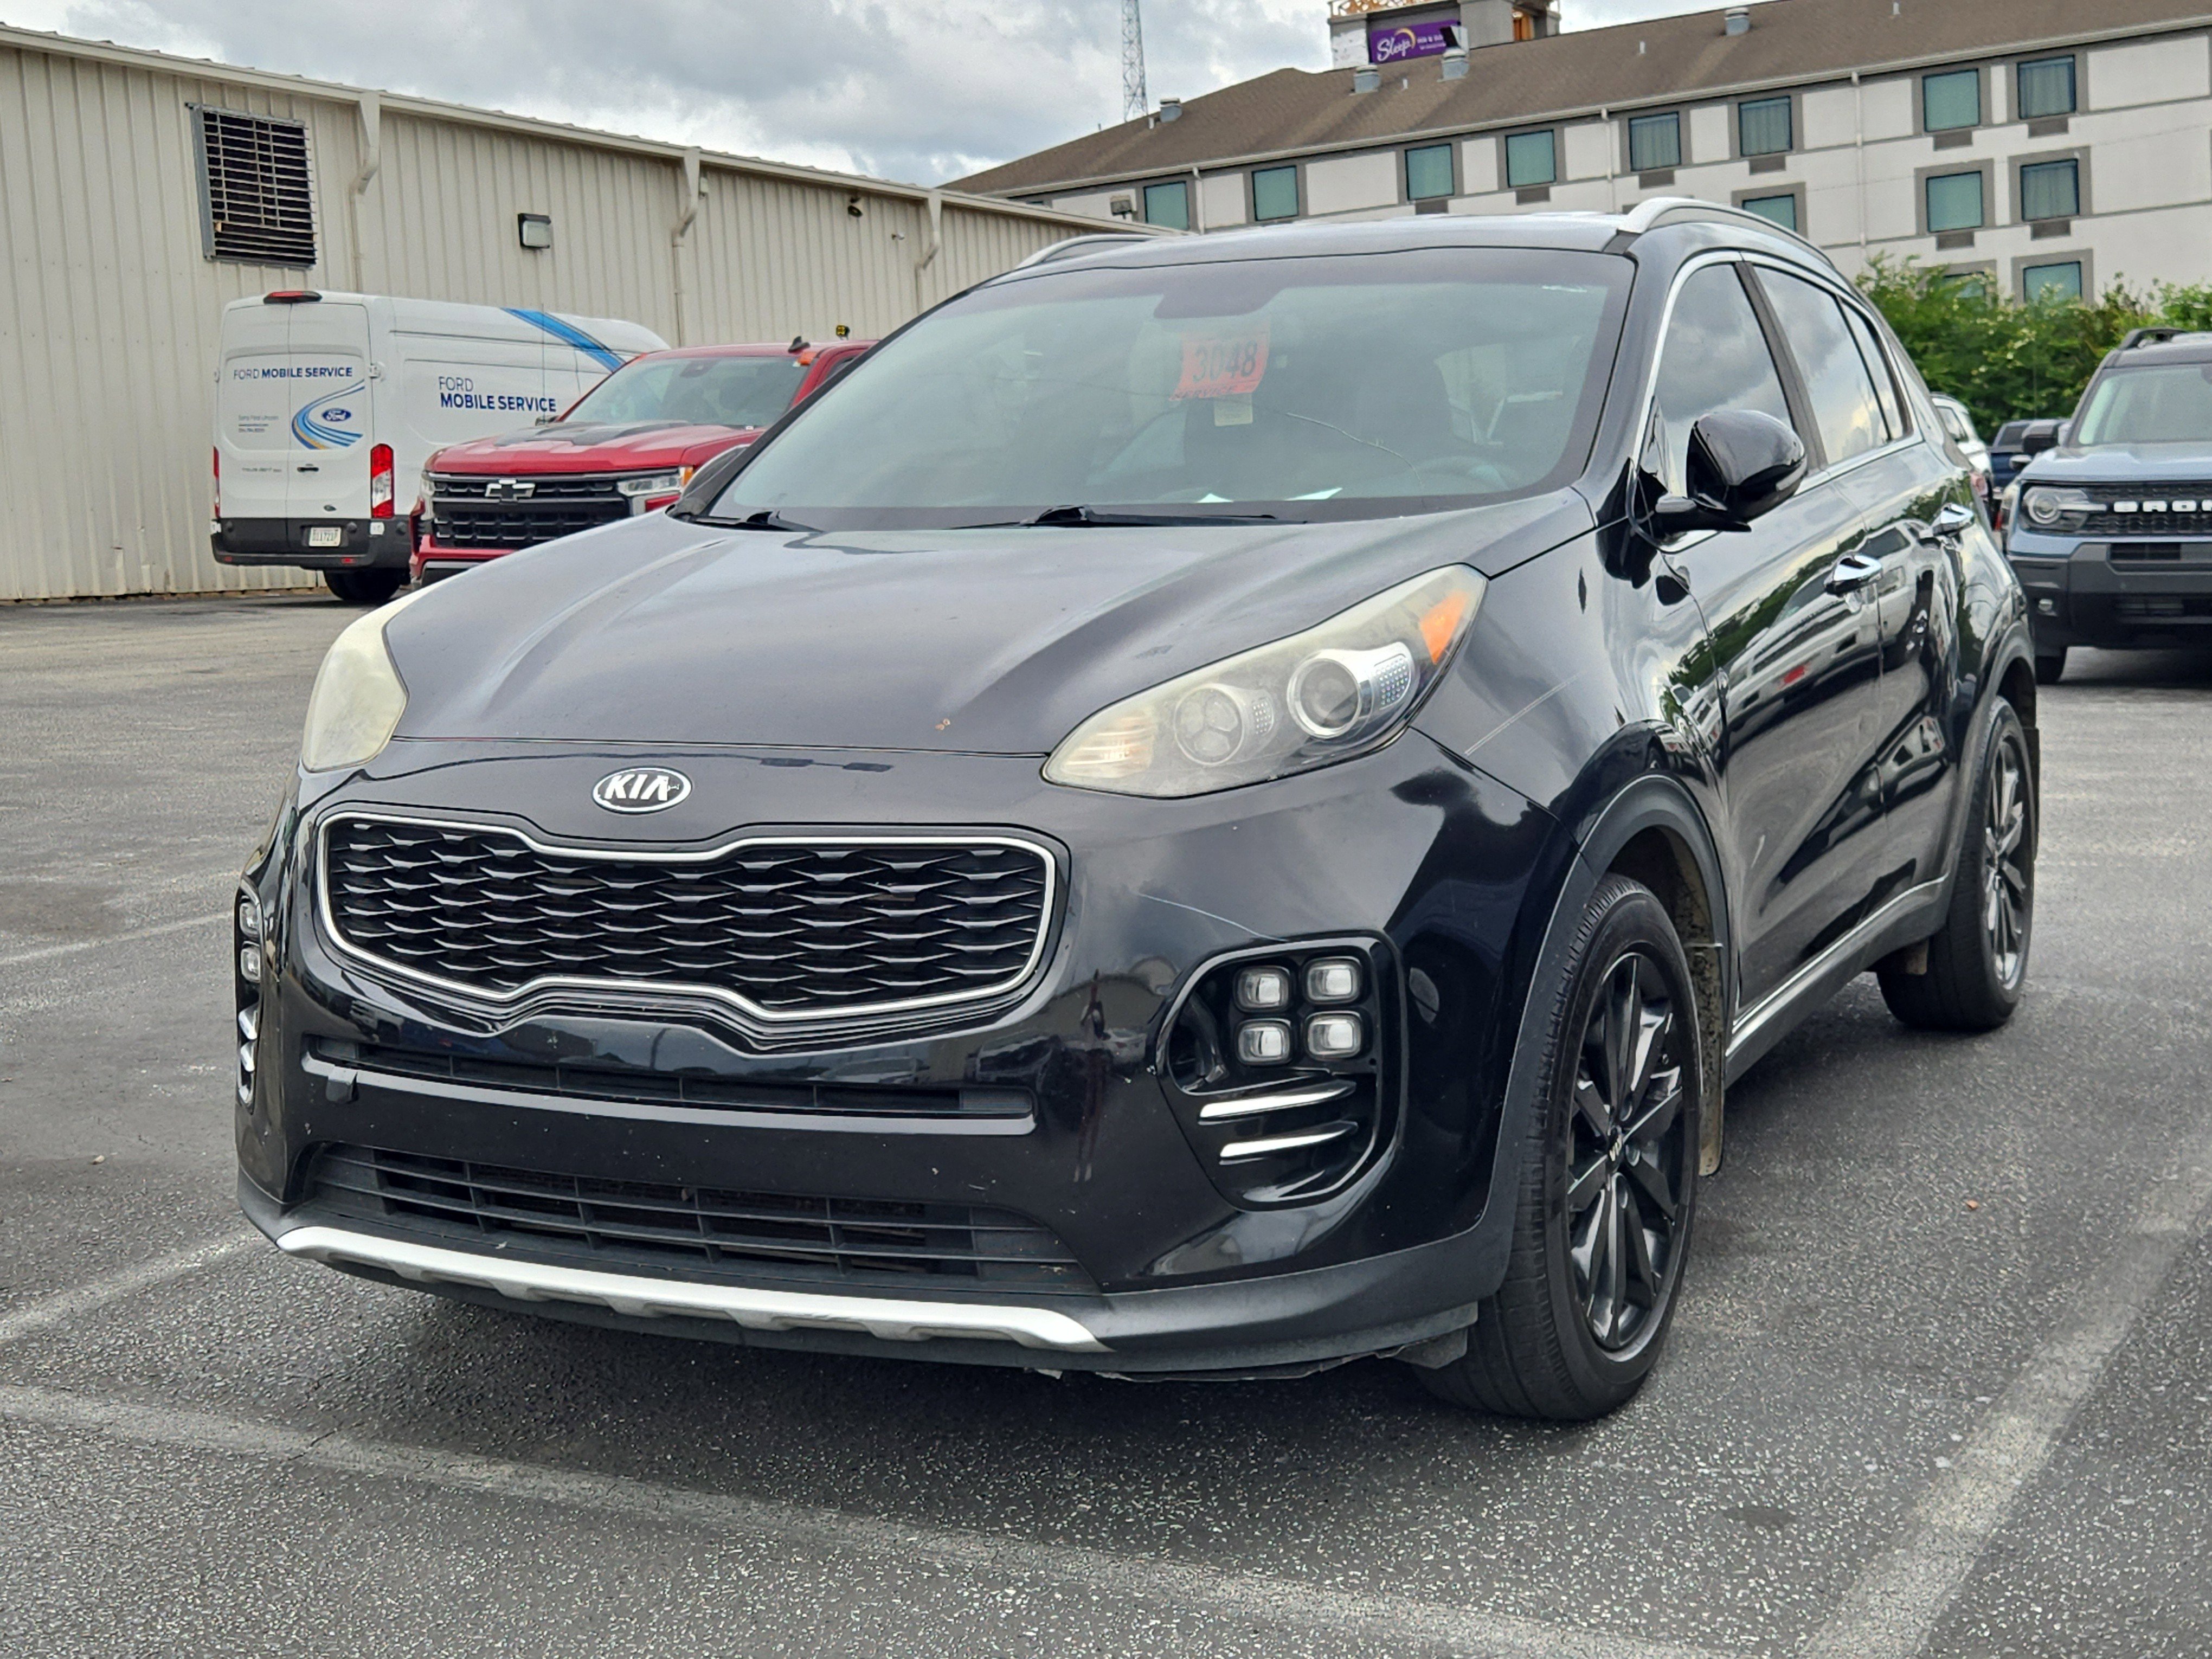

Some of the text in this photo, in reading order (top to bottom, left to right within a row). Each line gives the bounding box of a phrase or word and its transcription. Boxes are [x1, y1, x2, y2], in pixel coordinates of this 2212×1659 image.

[234, 367, 352, 380] FORD MOBILE SERVICE
[438, 376, 473, 392] FORD
[440, 393, 557, 412] MOBILE SERVICE
[604, 774, 670, 801] KIA
